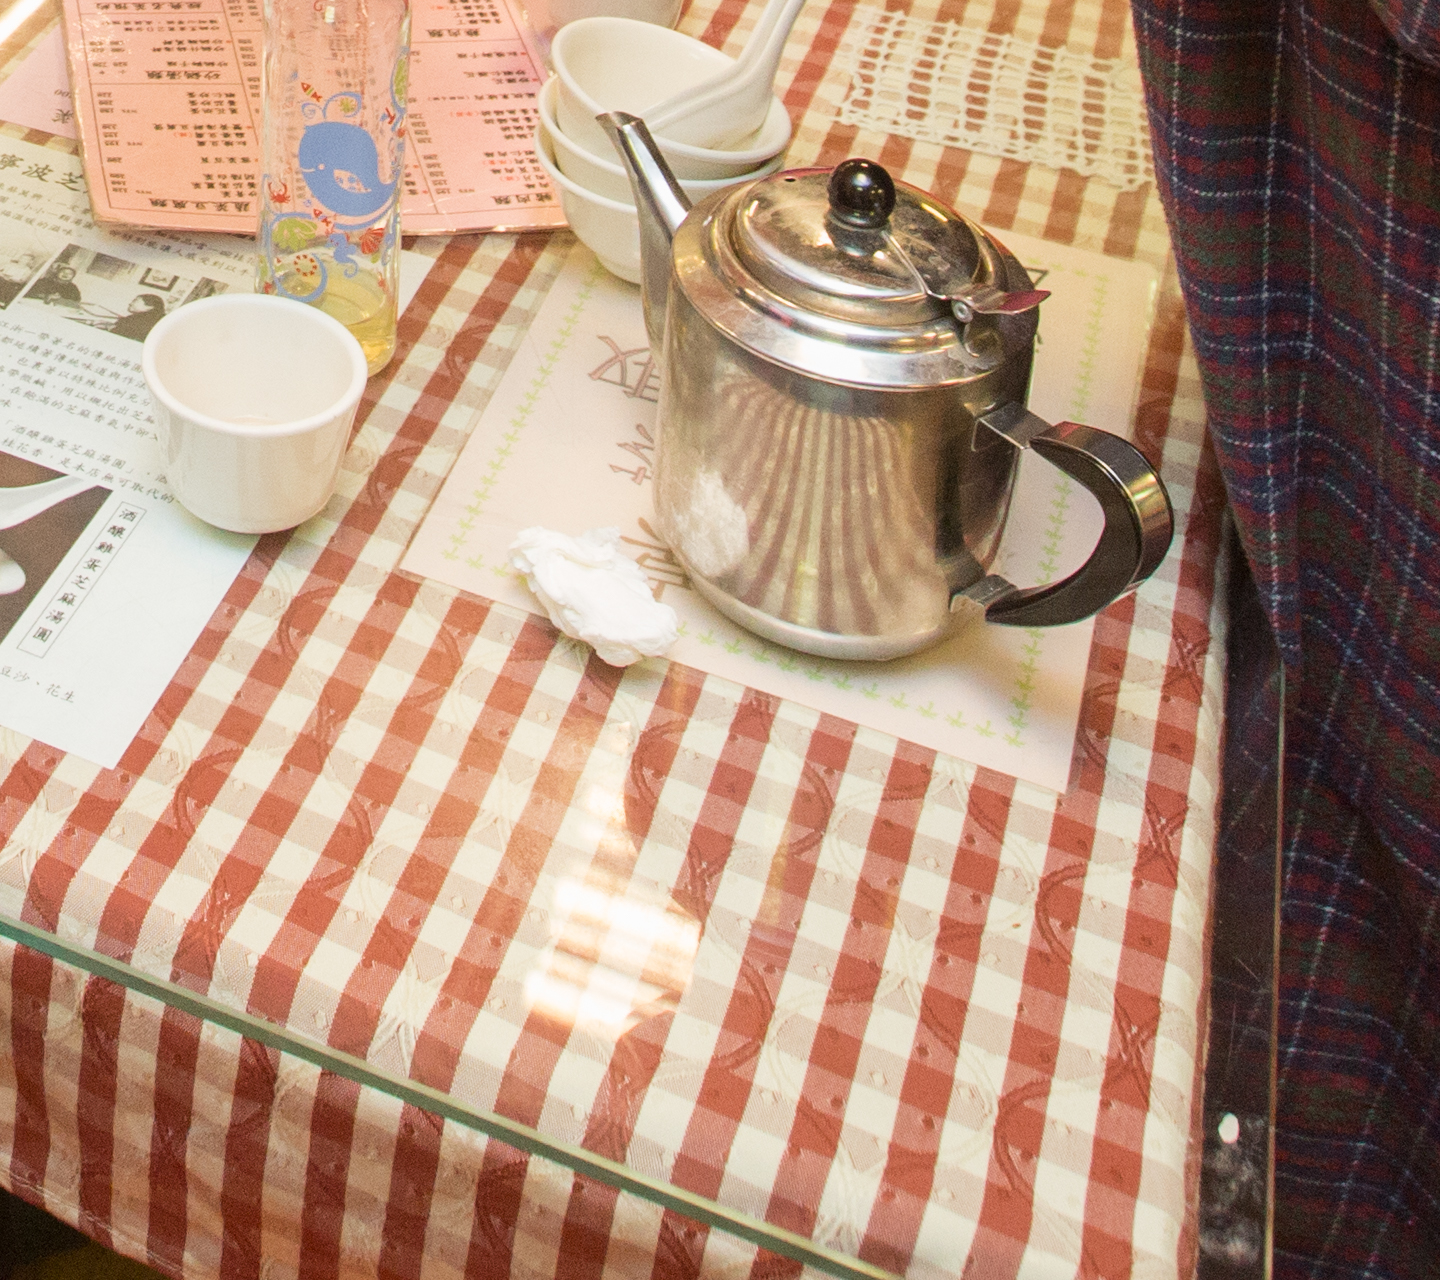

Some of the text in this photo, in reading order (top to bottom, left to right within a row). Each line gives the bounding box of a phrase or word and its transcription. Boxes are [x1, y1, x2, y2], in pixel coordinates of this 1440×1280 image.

[144, 69, 221, 79] 砂鍋湯類
[33, 507, 138, 645] 酒釀雞蛋芝麻湯圓
